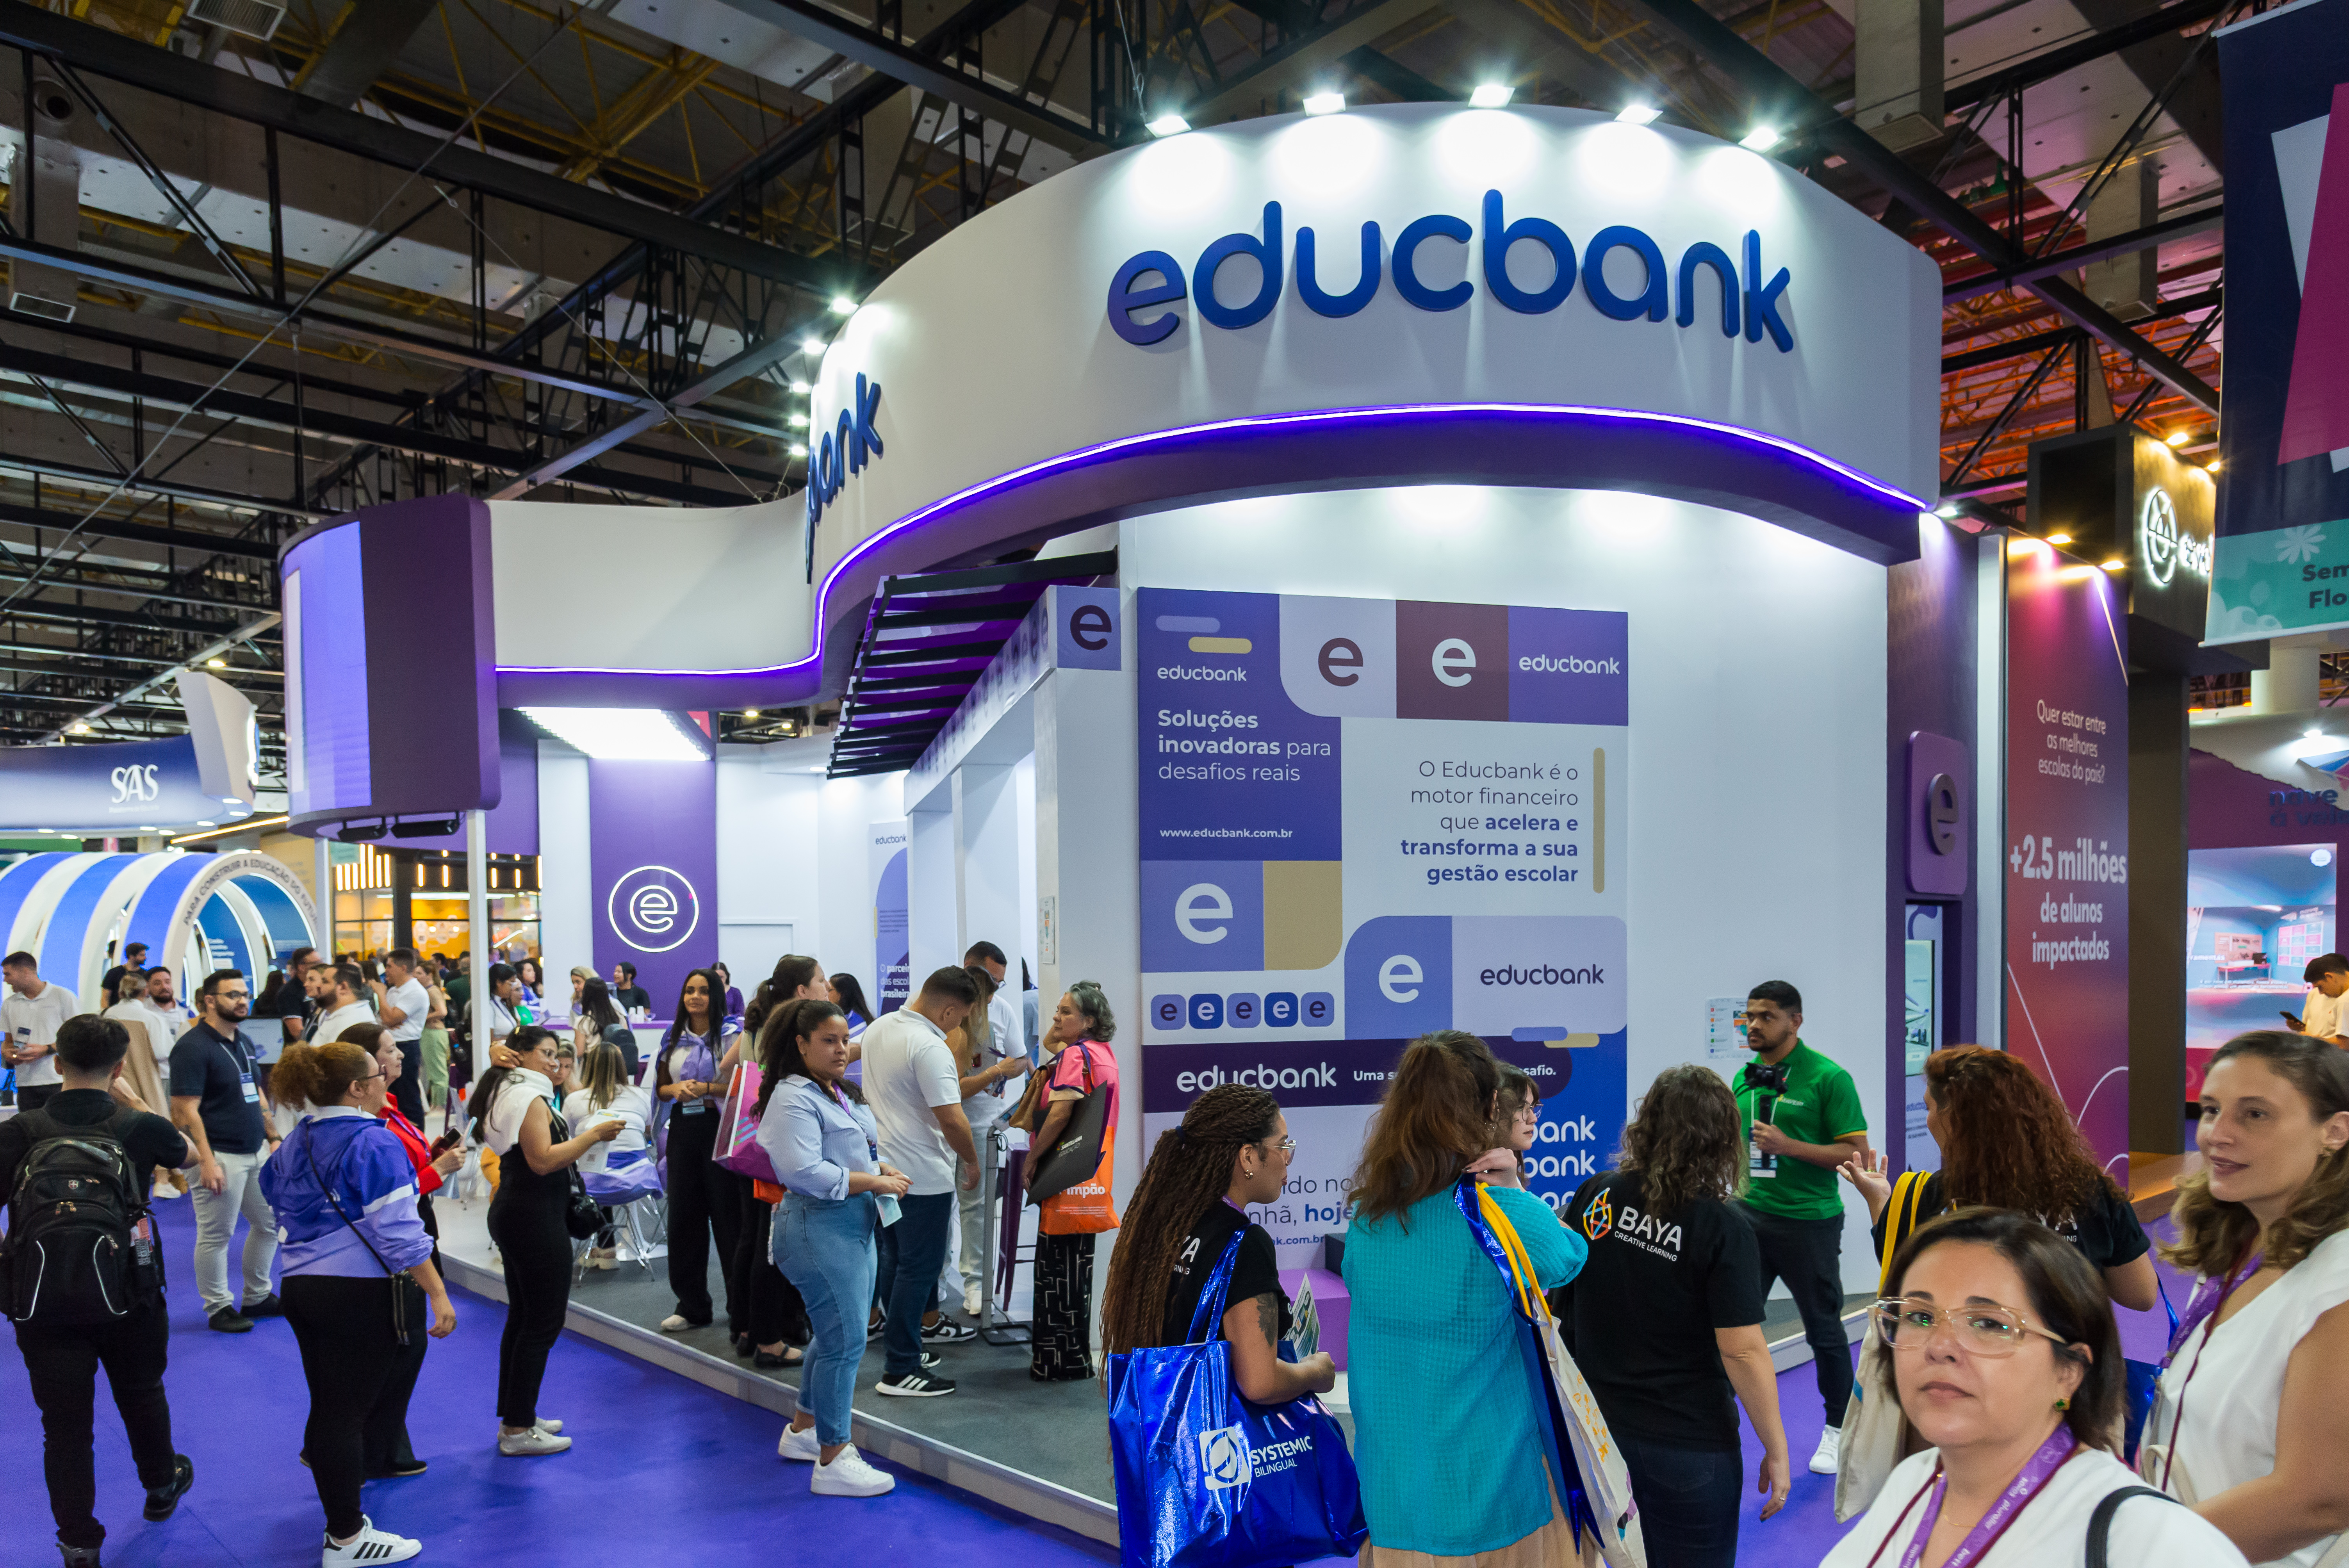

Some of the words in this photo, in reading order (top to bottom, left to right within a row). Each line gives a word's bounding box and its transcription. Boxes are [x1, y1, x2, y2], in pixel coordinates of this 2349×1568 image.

[1107, 189, 1794, 353] educbank
[2309, 589, 2349, 609] Flo
[1070, 605, 1112, 651] e
[1158, 665, 1246, 681] educbank
[1318, 638, 1363, 686] e
[1432, 638, 1476, 686] e
[1519, 654, 1619, 674] educbank
[1158, 709, 1259, 732] Soluções
[2036, 699, 2060, 723] Quer
[2061, 710, 2084, 729] estar
[2085, 716, 2107, 735] entre
[1158, 734, 1281, 755] inovadoras
[1288, 743, 1330, 759] para
[2047, 734, 2057, 750] as
[2059, 733, 2098, 757] melhores
[1159, 762, 1246, 780] desafios
[1253, 764, 1300, 780] reais
[1419, 761, 1435, 777] O
[1443, 761, 1543, 779] Educbank
[1550, 764, 1560, 779] é
[1567, 768, 1577, 780] o
[2038, 755, 2070, 778] escolas
[2072, 759, 2083, 780] do
[111, 764, 159, 804] SAS
[1412, 789, 1473, 803] motor
[1479, 788, 1577, 805] financeiro
[1160, 829, 1292, 837] www.educbank.com.br
[1441, 817, 1479, 833] que
[1486, 814, 1559, 830] acelera
[1567, 819, 1578, 831] e
[875, 834, 907, 845] educbank
[1401, 839, 1518, 855] transforma
[1526, 844, 1536, 855] a
[1543, 844, 1577, 856] sua
[2010, 834, 2053, 880] +2.5
[2057, 837, 2126, 884] milhões
[1428, 865, 1498, 885] gestão
[1505, 866, 1578, 881] escolar
[1175, 883, 1233, 944] e
[2041, 892, 2058, 923] de
[2060, 893, 2103, 923] alunos
[2032, 930, 2110, 970] impactados
[1378, 954, 1423, 1003] e
[1481, 964, 1604, 985] educbank
[1160, 1003, 1177, 1021] e
[1198, 1003, 1215, 1020] e
[1236, 1002, 1252, 1019] e
[1273, 1001, 1289, 1018] e
[1310, 1001, 1325, 1018] e
[1176, 1061, 1337, 1092] educbank
[1354, 1071, 1384, 1081] Uma
[1519, 1064, 1556, 1076] safio.
[1618, 1206, 1681, 1251] BAYA
[1614, 1231, 1645, 1249] CREATIVE
[1647, 1244, 1677, 1262] LEARNING
[1250, 1436, 1313, 1465] SYSTEMIC
[1254, 1458, 1297, 1477] BILINGUAL
